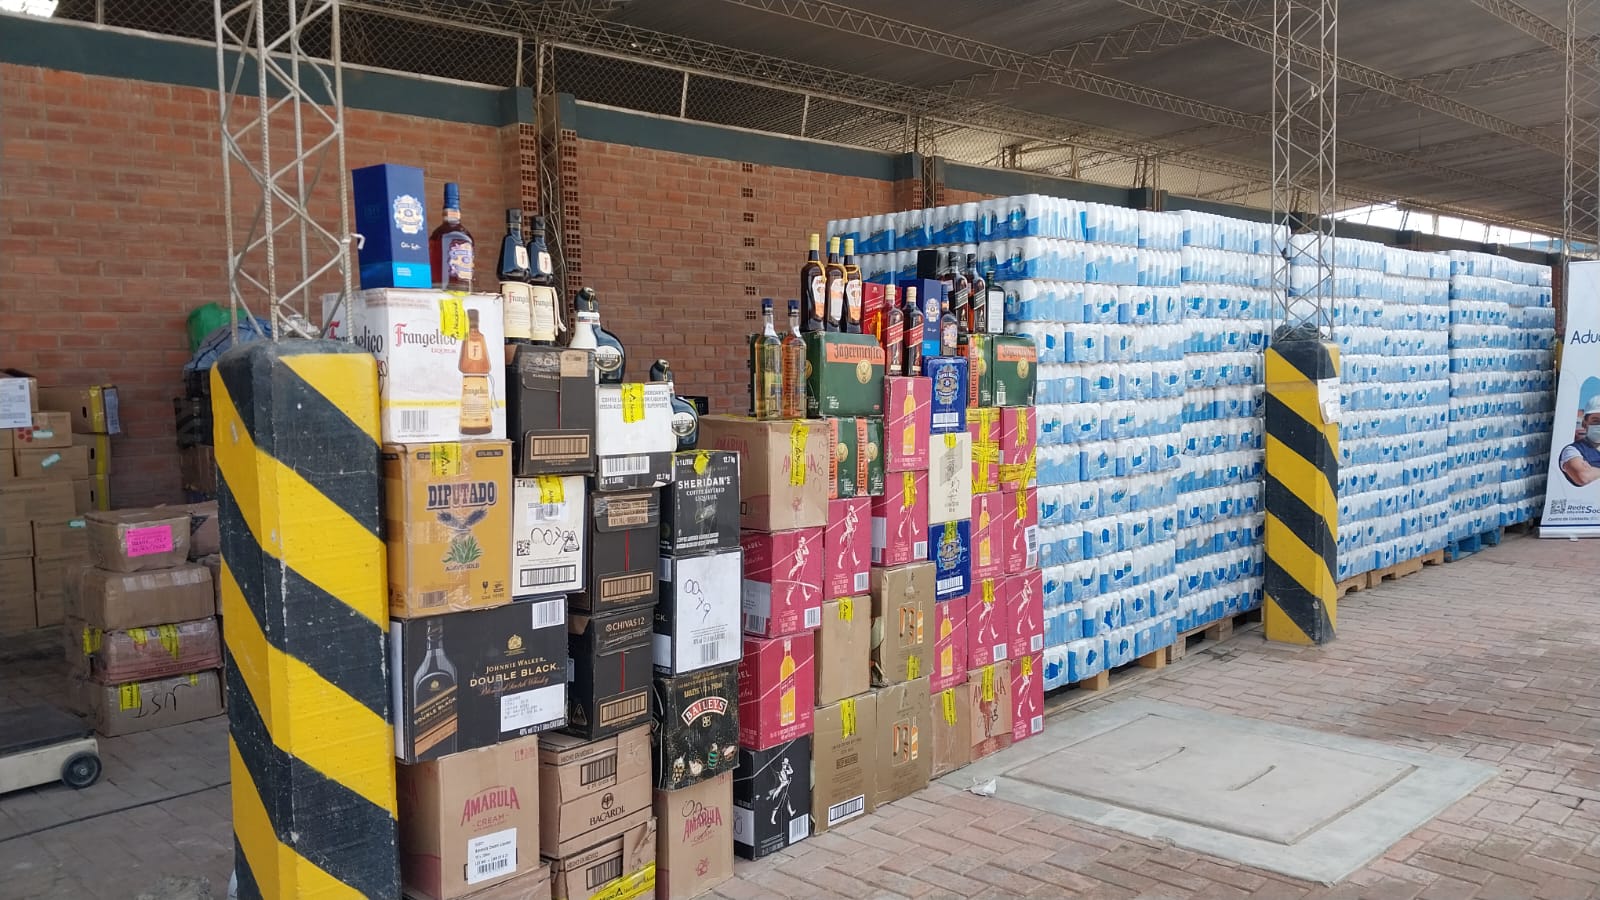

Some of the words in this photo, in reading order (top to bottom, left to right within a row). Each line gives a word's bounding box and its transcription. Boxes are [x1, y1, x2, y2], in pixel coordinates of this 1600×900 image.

[328, 320, 383, 353] Felico
[678, 476, 731, 490] SHERIDAN'S
[427, 481, 496, 508] DIPUTADO
[612, 618, 637, 631] CHIVAS
[638, 616, 645, 625] 12
[469, 671, 517, 687] DOUBLE
[521, 662, 557, 677] BLACK
[486, 663, 516, 674] JOHNNIE
[517, 657, 545, 667] WALKER
[685, 699, 726, 720] BAILEYS
[460, 786, 520, 826] AMARULA
[589, 806, 625, 826] BACARDI
[476, 813, 505, 827] CREAM
